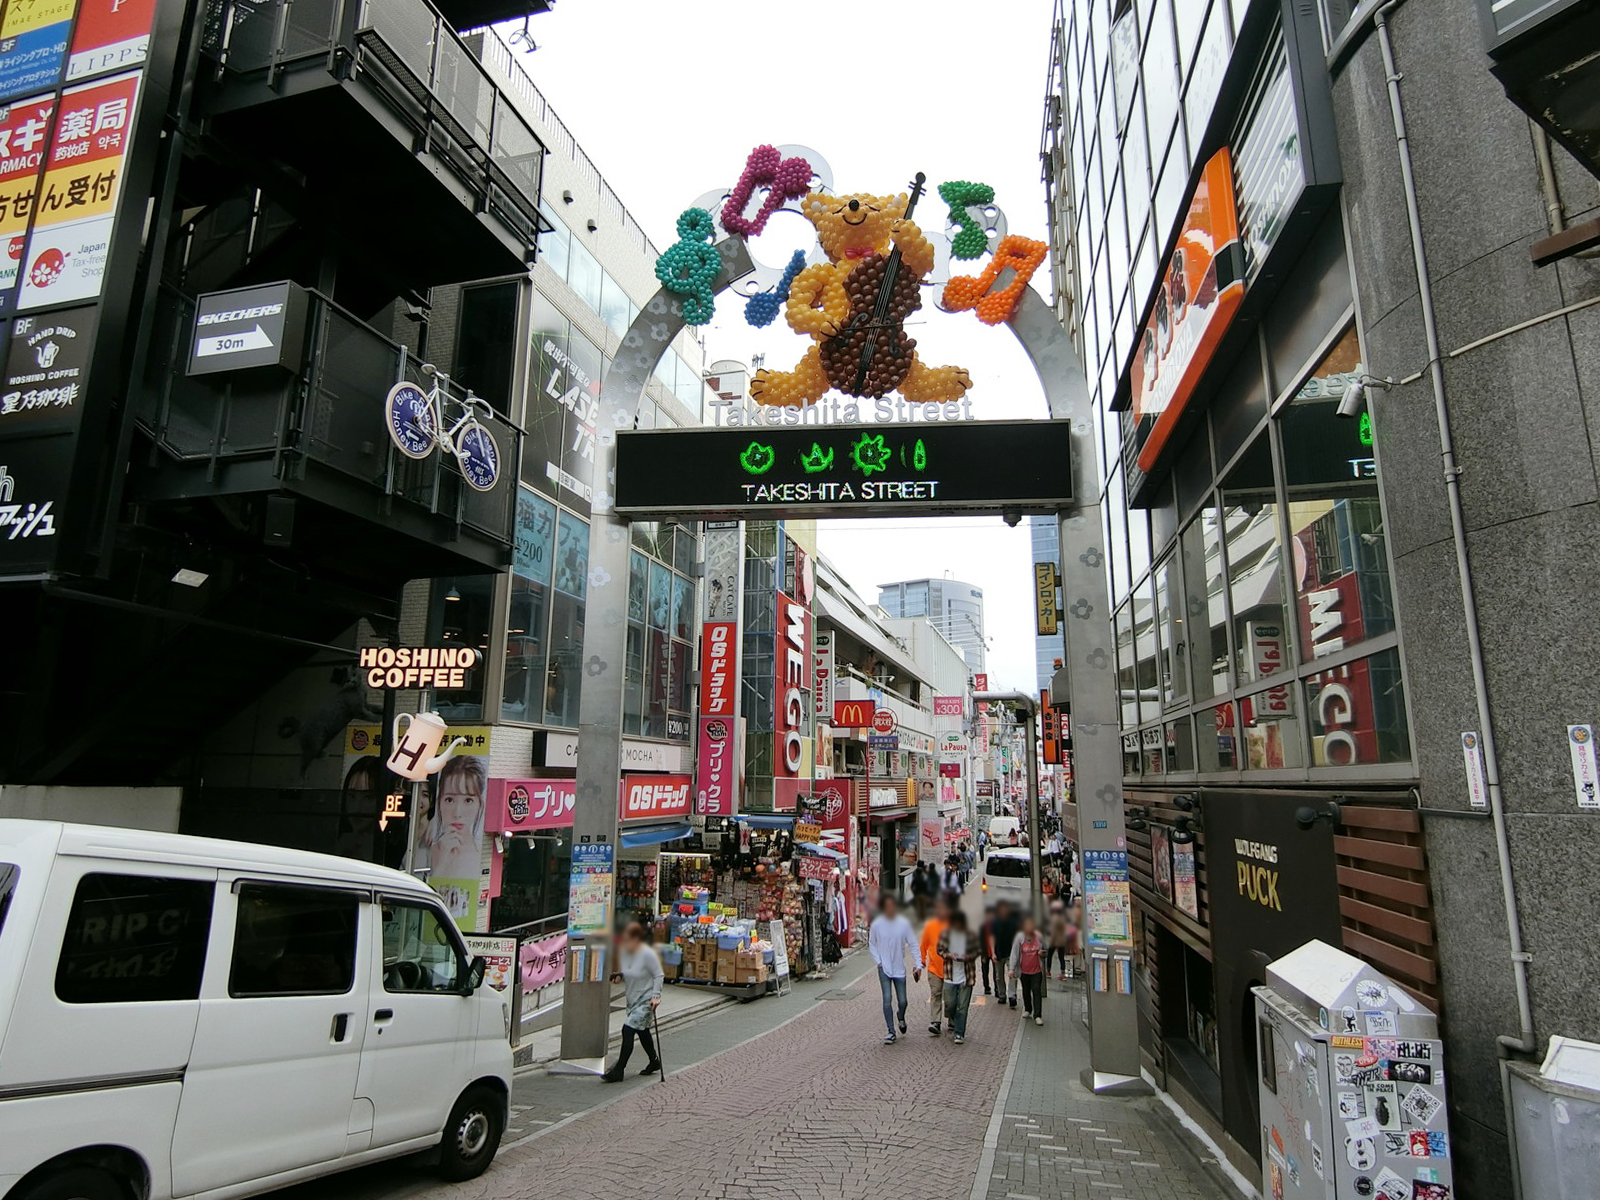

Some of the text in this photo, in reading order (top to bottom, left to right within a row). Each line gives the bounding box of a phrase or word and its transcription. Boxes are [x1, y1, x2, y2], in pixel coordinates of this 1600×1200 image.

[2, 40, 16, 52] 5F
[69, 43, 148, 76] LIPPS
[58, 98, 128, 143] 薬局
[77, 241, 107, 254] Japan
[72, 254, 107, 268] Tax-free
[81, 267, 105, 278] Shop
[197, 303, 284, 326] SKECHERS
[15, 318, 34, 335] BF
[28, 326, 77, 347] HAND DRIP
[216, 338, 244, 351] 30m
[9, 367, 80, 386] HOSHINO COFFEE
[1, 382, 81, 415] 星乃珈琲
[394, 390, 414, 406] Bike
[708, 395, 975, 427] Takeshita Street
[393, 410, 411, 449] Honey
[412, 441, 428, 451] Bee
[479, 475, 493, 485] Bee
[740, 480, 940, 502] TAKESHITA STREET
[1038, 564, 1054, 626] コインロッカー
[360, 648, 476, 668] HOSHINO
[367, 668, 465, 688] COFFEE
[784, 603, 805, 773] WEGO
[936, 704, 960, 714] ¥300
[625, 750, 653, 762] MOCHA
[940, 743, 948, 751] La
[386, 795, 403, 811] BF
[1234, 838, 1278, 864] WOLFGANG
[1236, 860, 1282, 912] PUCK
[1332, 1035, 1364, 1049] RUTHLESS
